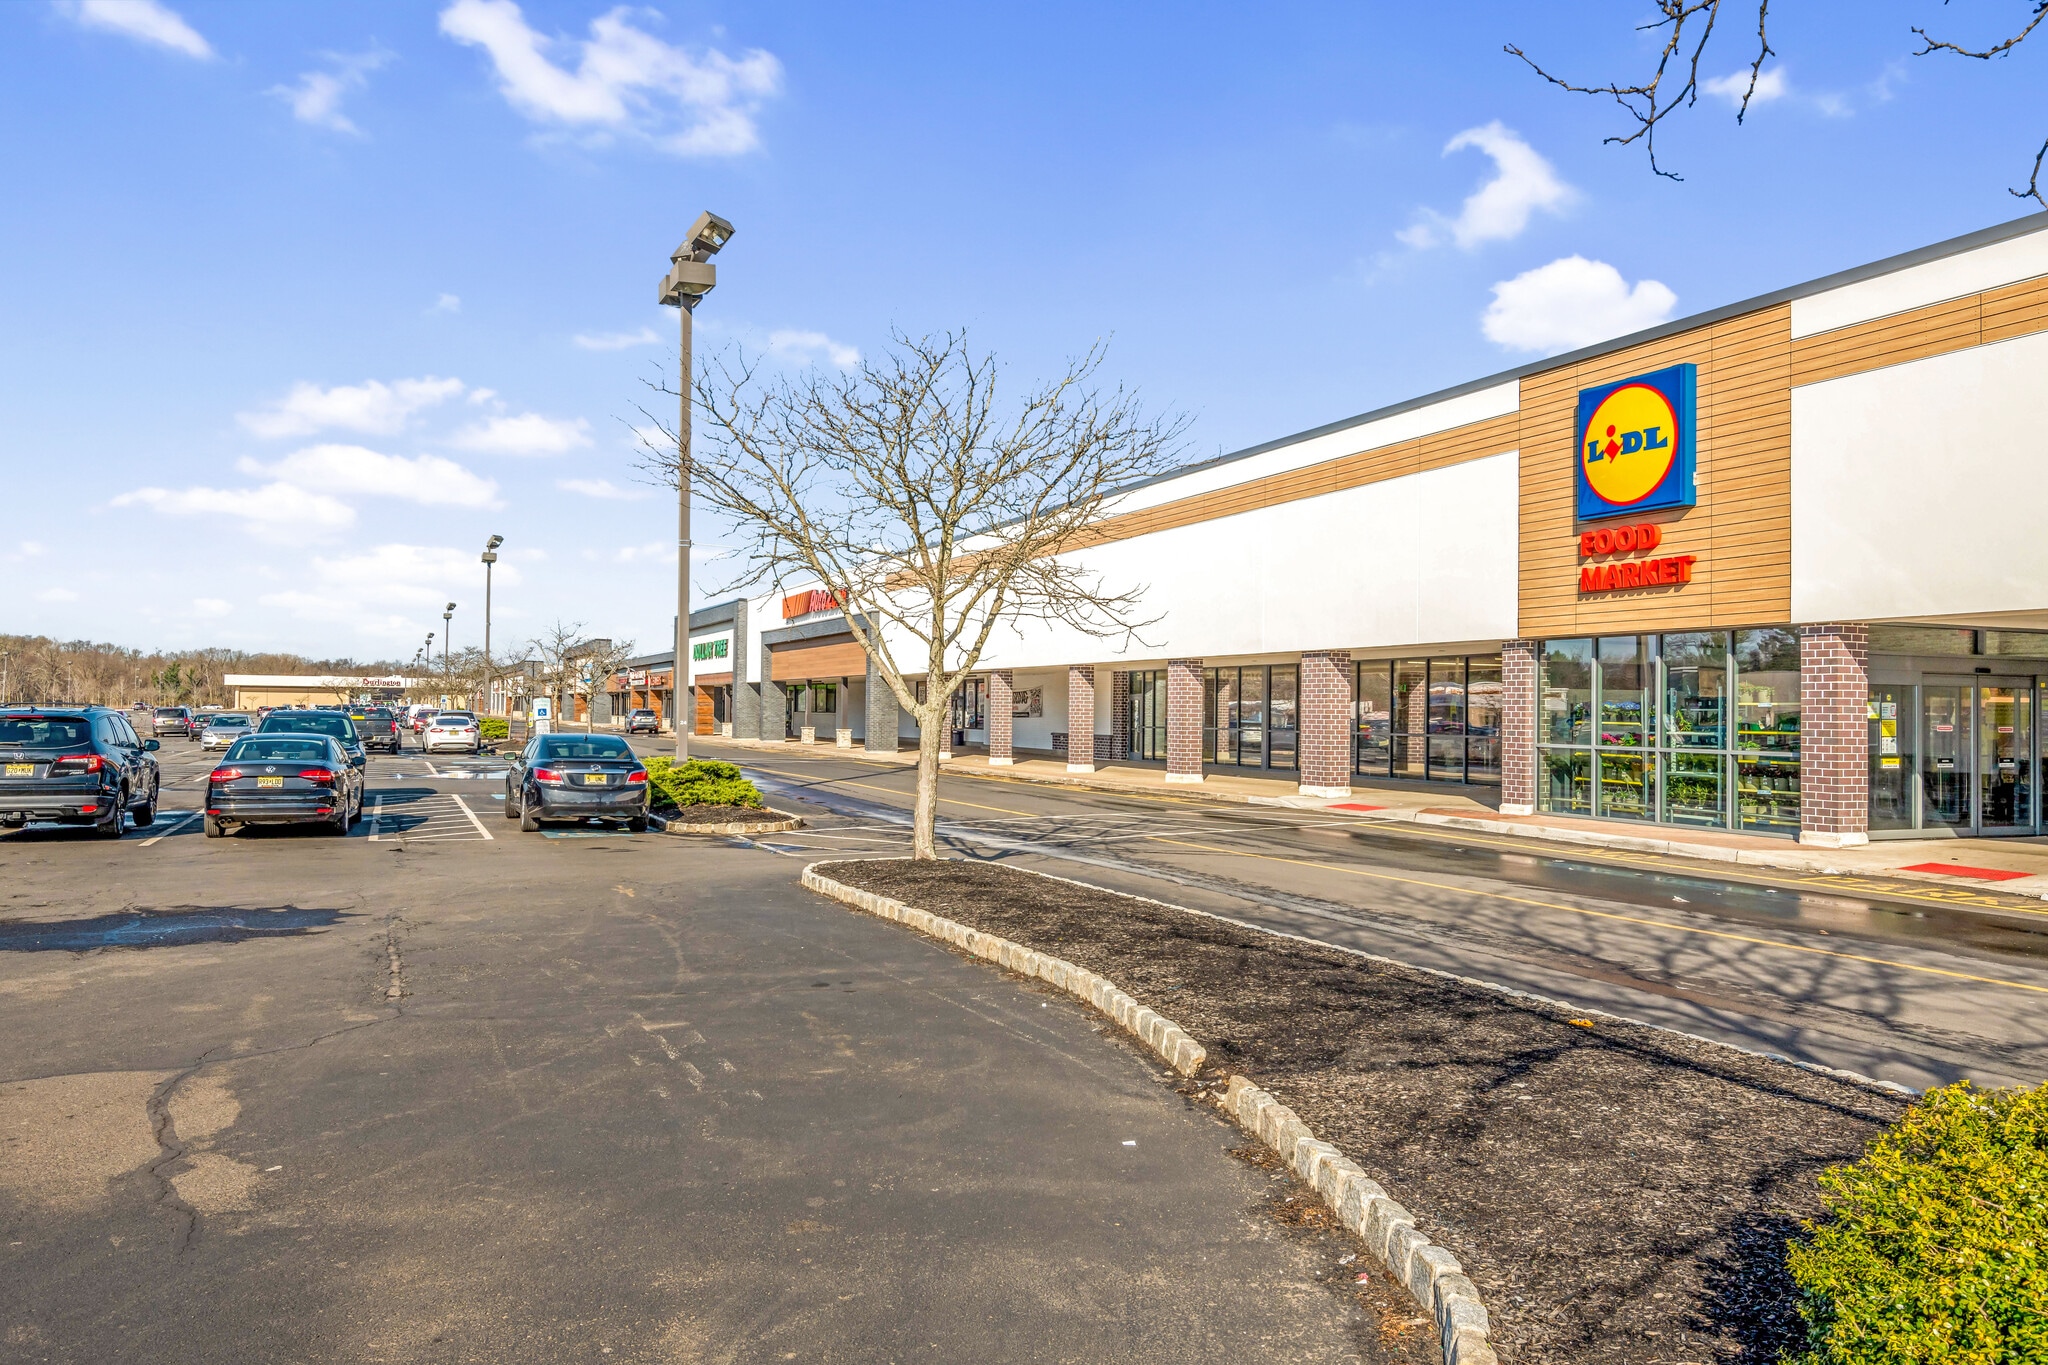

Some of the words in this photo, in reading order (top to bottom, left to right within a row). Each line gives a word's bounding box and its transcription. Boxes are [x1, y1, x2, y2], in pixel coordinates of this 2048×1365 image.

[1581, 524, 1661, 556] FOOD
[1581, 556, 1696, 592] MARKET
[693, 642, 713, 660] DOLLAR
[714, 639, 728, 657] TREE
[363, 678, 401, 687] Burlington
